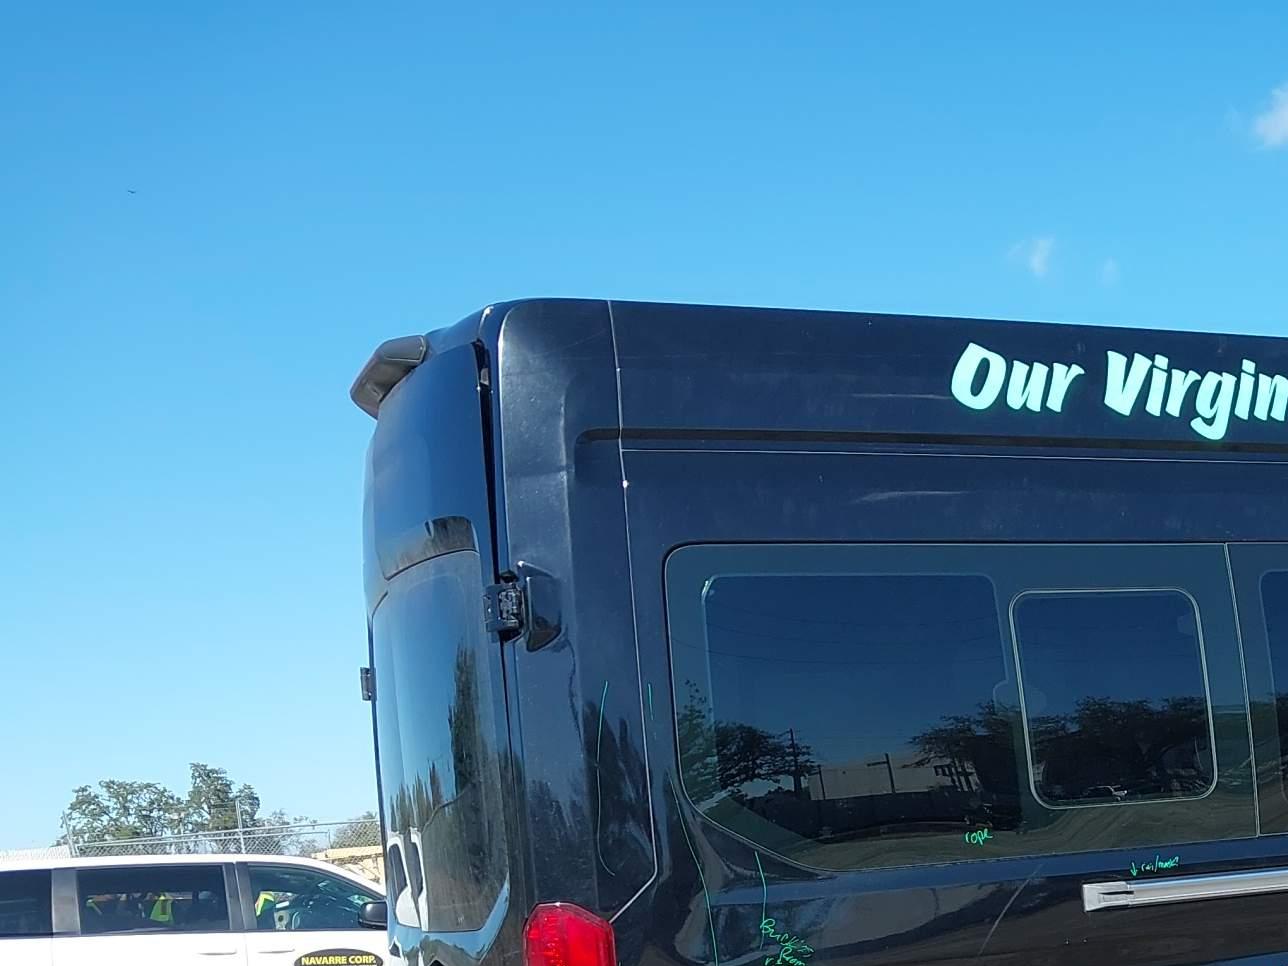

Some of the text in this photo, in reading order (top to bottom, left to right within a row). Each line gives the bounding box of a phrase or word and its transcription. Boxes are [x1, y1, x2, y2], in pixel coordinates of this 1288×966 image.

[952, 342, 1085, 412] Our
[301, 955, 377, 965] NAVARRE CORP.
